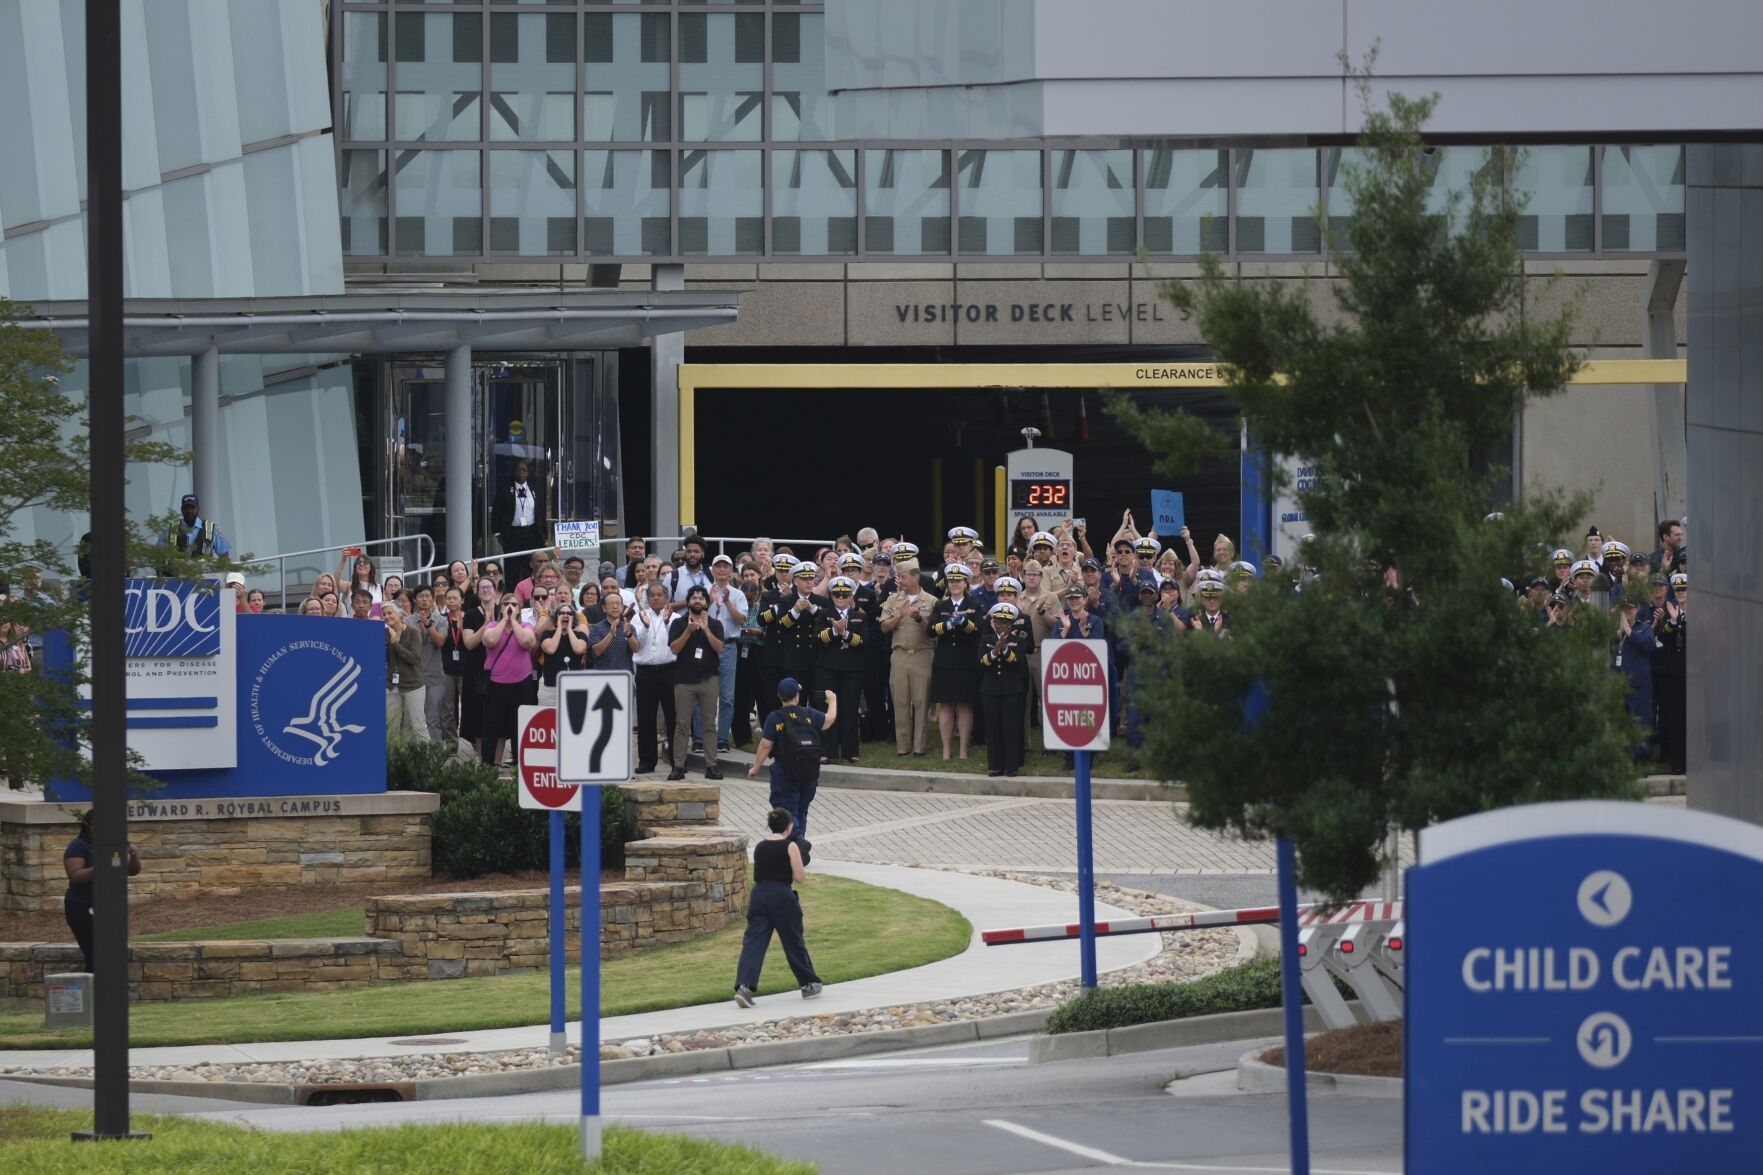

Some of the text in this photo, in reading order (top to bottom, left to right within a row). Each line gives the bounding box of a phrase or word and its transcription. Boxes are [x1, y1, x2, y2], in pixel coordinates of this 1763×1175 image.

[895, 304, 999, 323] VISITOR
[1011, 303, 1074, 322] DECK
[1086, 303, 1164, 322] LEVEL
[1136, 368, 1213, 379] CLEARANCE
[1029, 485, 1066, 504] 232
[556, 522, 581, 531] THANK
[289, 640, 330, 652] SERVICES
[259, 646, 288, 675] HUMAN
[1052, 662, 1097, 679] DO NOT
[250, 683, 260, 722] HEALTH
[1057, 709, 1095, 726] ENTER
[254, 723, 265, 735] OF
[529, 727, 546, 743] DO
[261, 735, 313, 765] DEPARTMENT
[128, 800, 341, 817] EDWARD R. ROYBAL CAMPUS
[1462, 946, 1732, 991] CHILD CARE
[1461, 1088, 1733, 1133] RIDE SHARE
